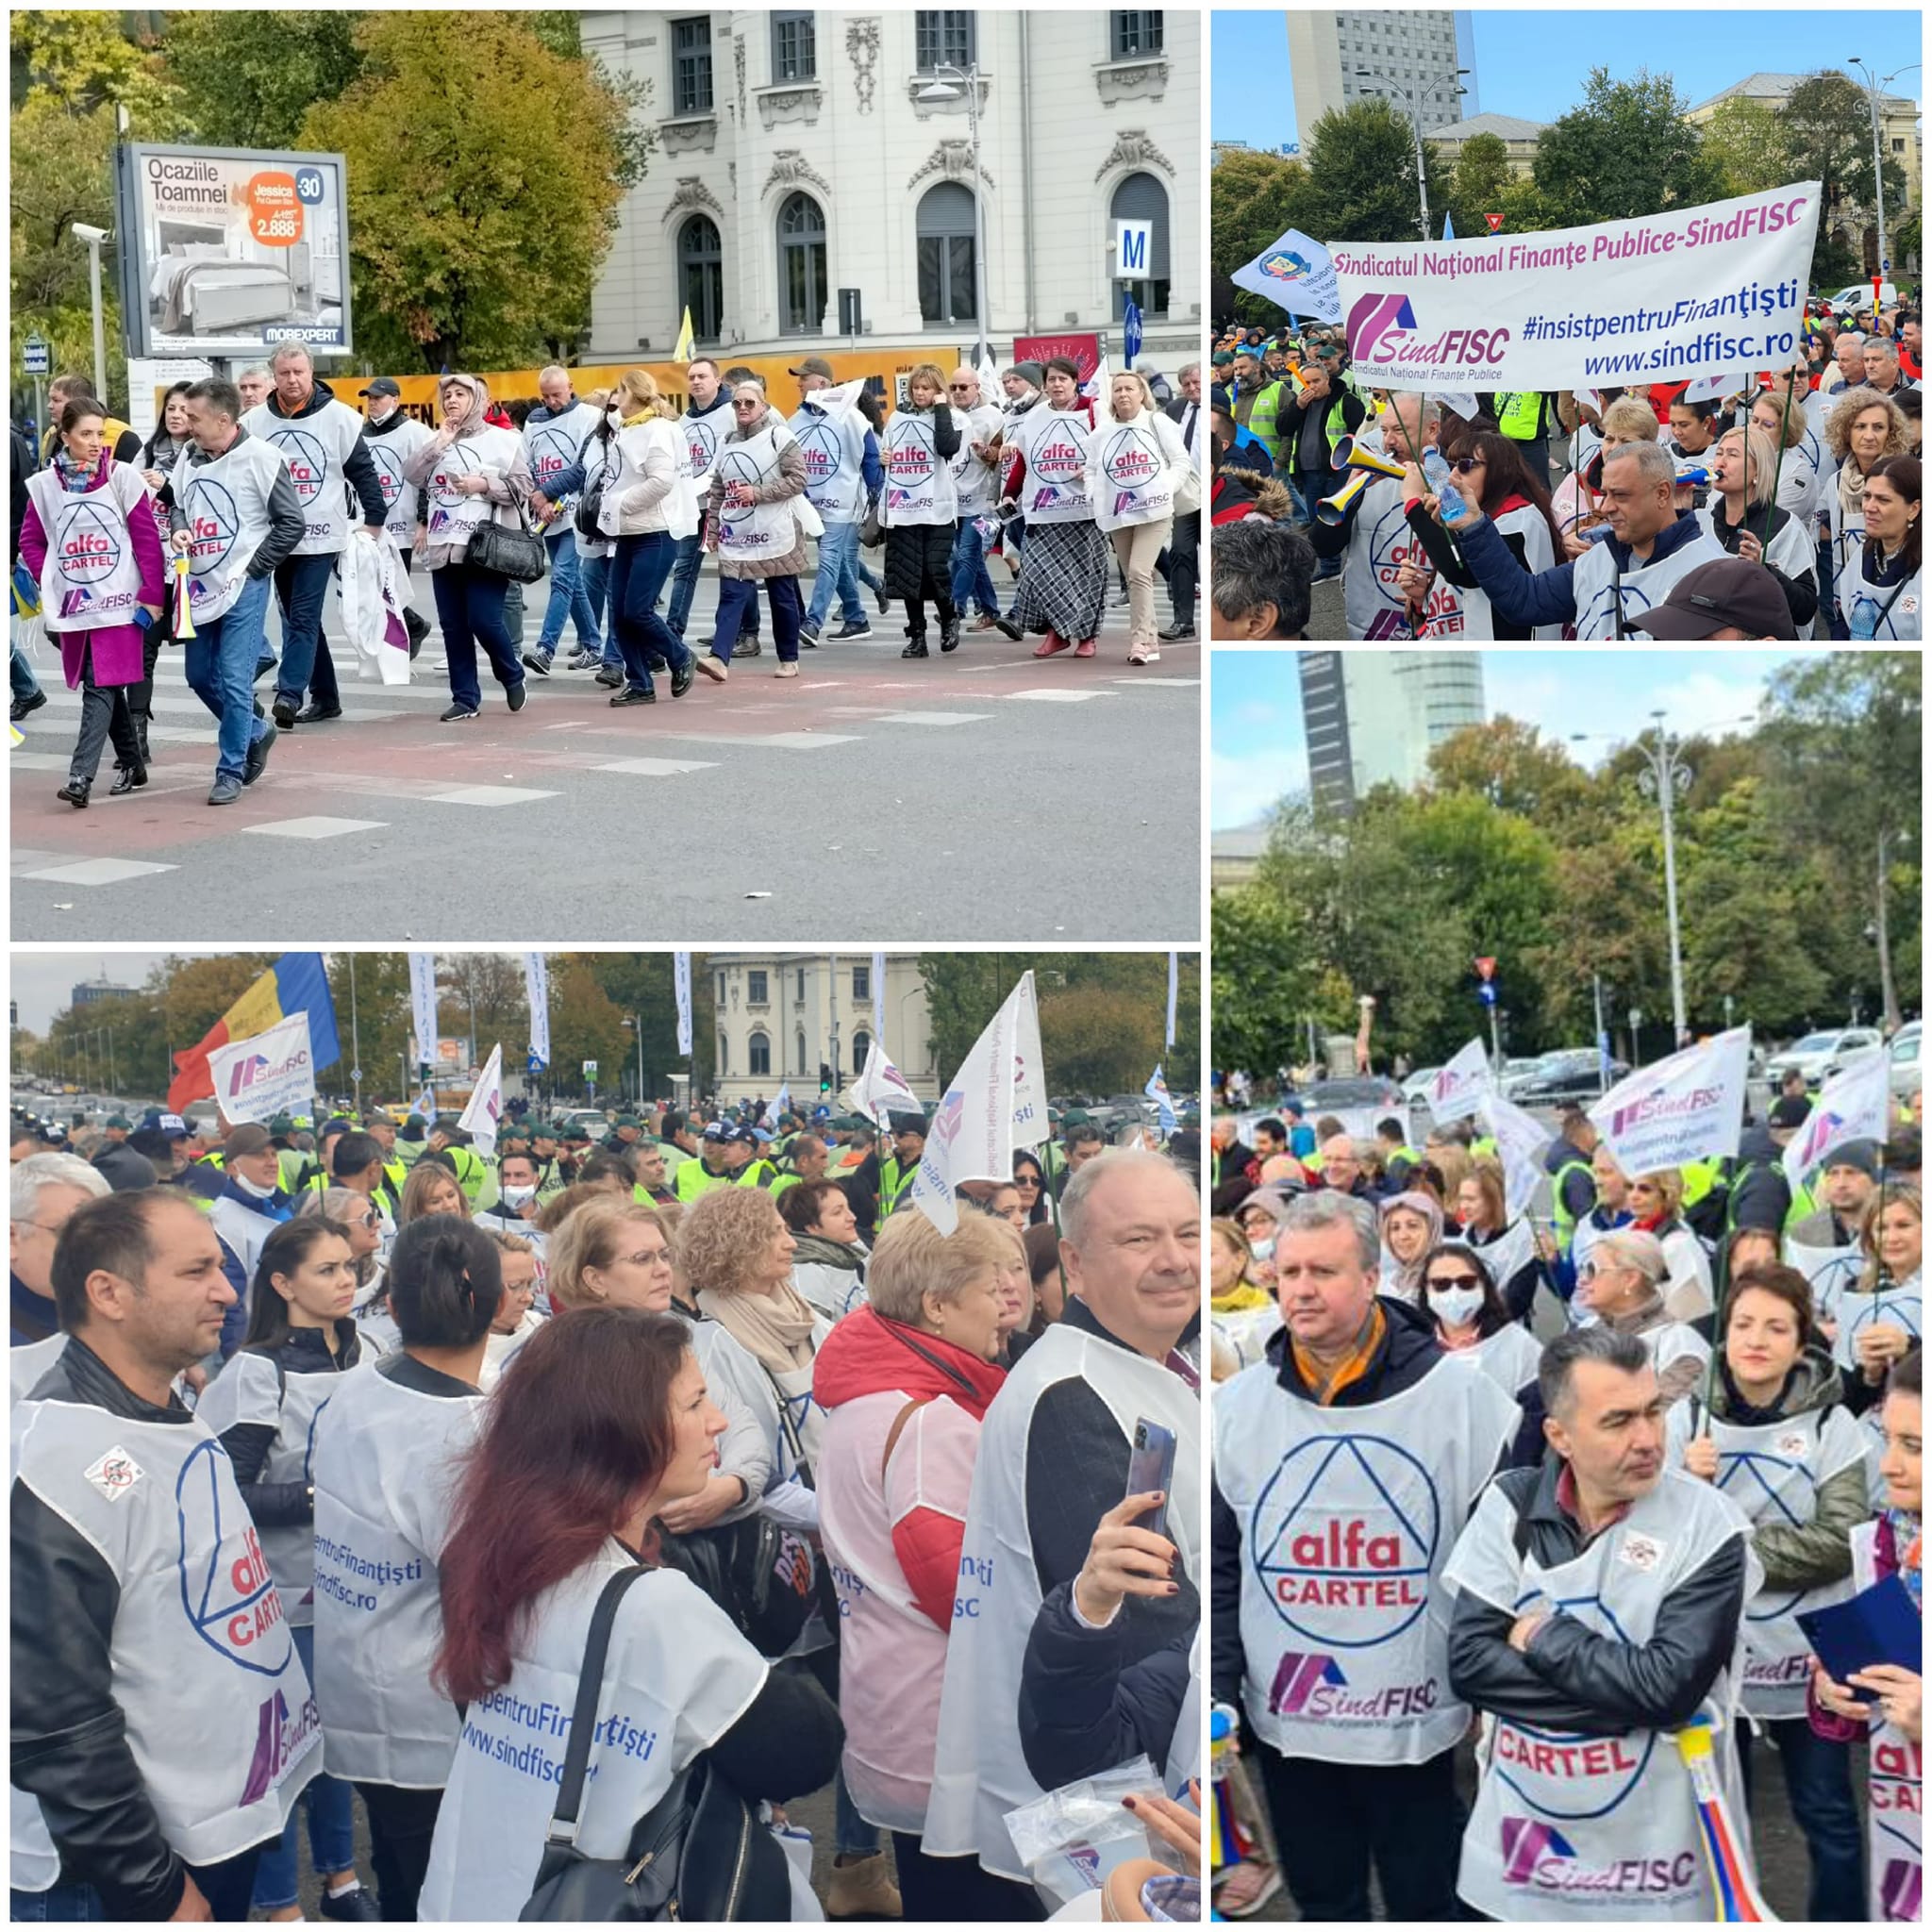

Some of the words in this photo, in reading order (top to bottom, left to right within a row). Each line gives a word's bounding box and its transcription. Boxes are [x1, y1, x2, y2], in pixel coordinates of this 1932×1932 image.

[148, 158, 219, 182] Ocaziile
[151, 180, 227, 204] Toamnei
[255, 184, 293, 196] Jessica
[257, 219, 296, 237] 2.888
[1335, 252, 1418, 276] Sindicatul
[1592, 197, 1807, 261] Publice-SindFISC
[1123, 229, 1145, 269] M
[266, 327, 339, 342] MOBEXPERT
[1373, 326, 1510, 365] SindFISC
[1585, 331, 1793, 376] www.sindfisc.ro
[1355, 363, 1389, 376] Sindicatul
[1467, 368, 1503, 380] Publice
[893, 446, 927, 462] alfa
[1042, 443, 1076, 459] alfa
[1116, 451, 1149, 467] alfa
[290, 461, 310, 480] fa
[807, 465, 831, 475] RTEL
[890, 464, 933, 475] CARTEL
[1113, 466, 1156, 479] CARTEL
[293, 484, 316, 494] TEL
[151, 498, 170, 515] fa
[896, 497, 934, 510] SindFIS
[1047, 494, 1087, 508] SindFIS
[304, 523, 331, 536] FISC
[389, 522, 408, 532] FISC
[65, 534, 108, 555] alfa
[190, 541, 226, 558] RTEL
[1391, 540, 1430, 567] alf
[62, 556, 114, 572] CARTEL
[1292, 1519, 1401, 1570] alfa
[230, 1526, 271, 1595] alf
[313, 1534, 423, 1586] entruFinanţişti
[313, 1566, 377, 1612] indfisc.ro
[1276, 1577, 1421, 1607] CARTEL
[227, 1590, 282, 1647] CART
[1744, 1653, 1808, 1682] indFI
[1309, 1677, 1438, 1717] SindFISC
[280, 1697, 321, 1767] SindFIS
[1497, 1731, 1638, 1777] CARTEL
[1874, 1741, 1923, 1776] al
[1536, 1850, 1696, 1892] SindFISC
